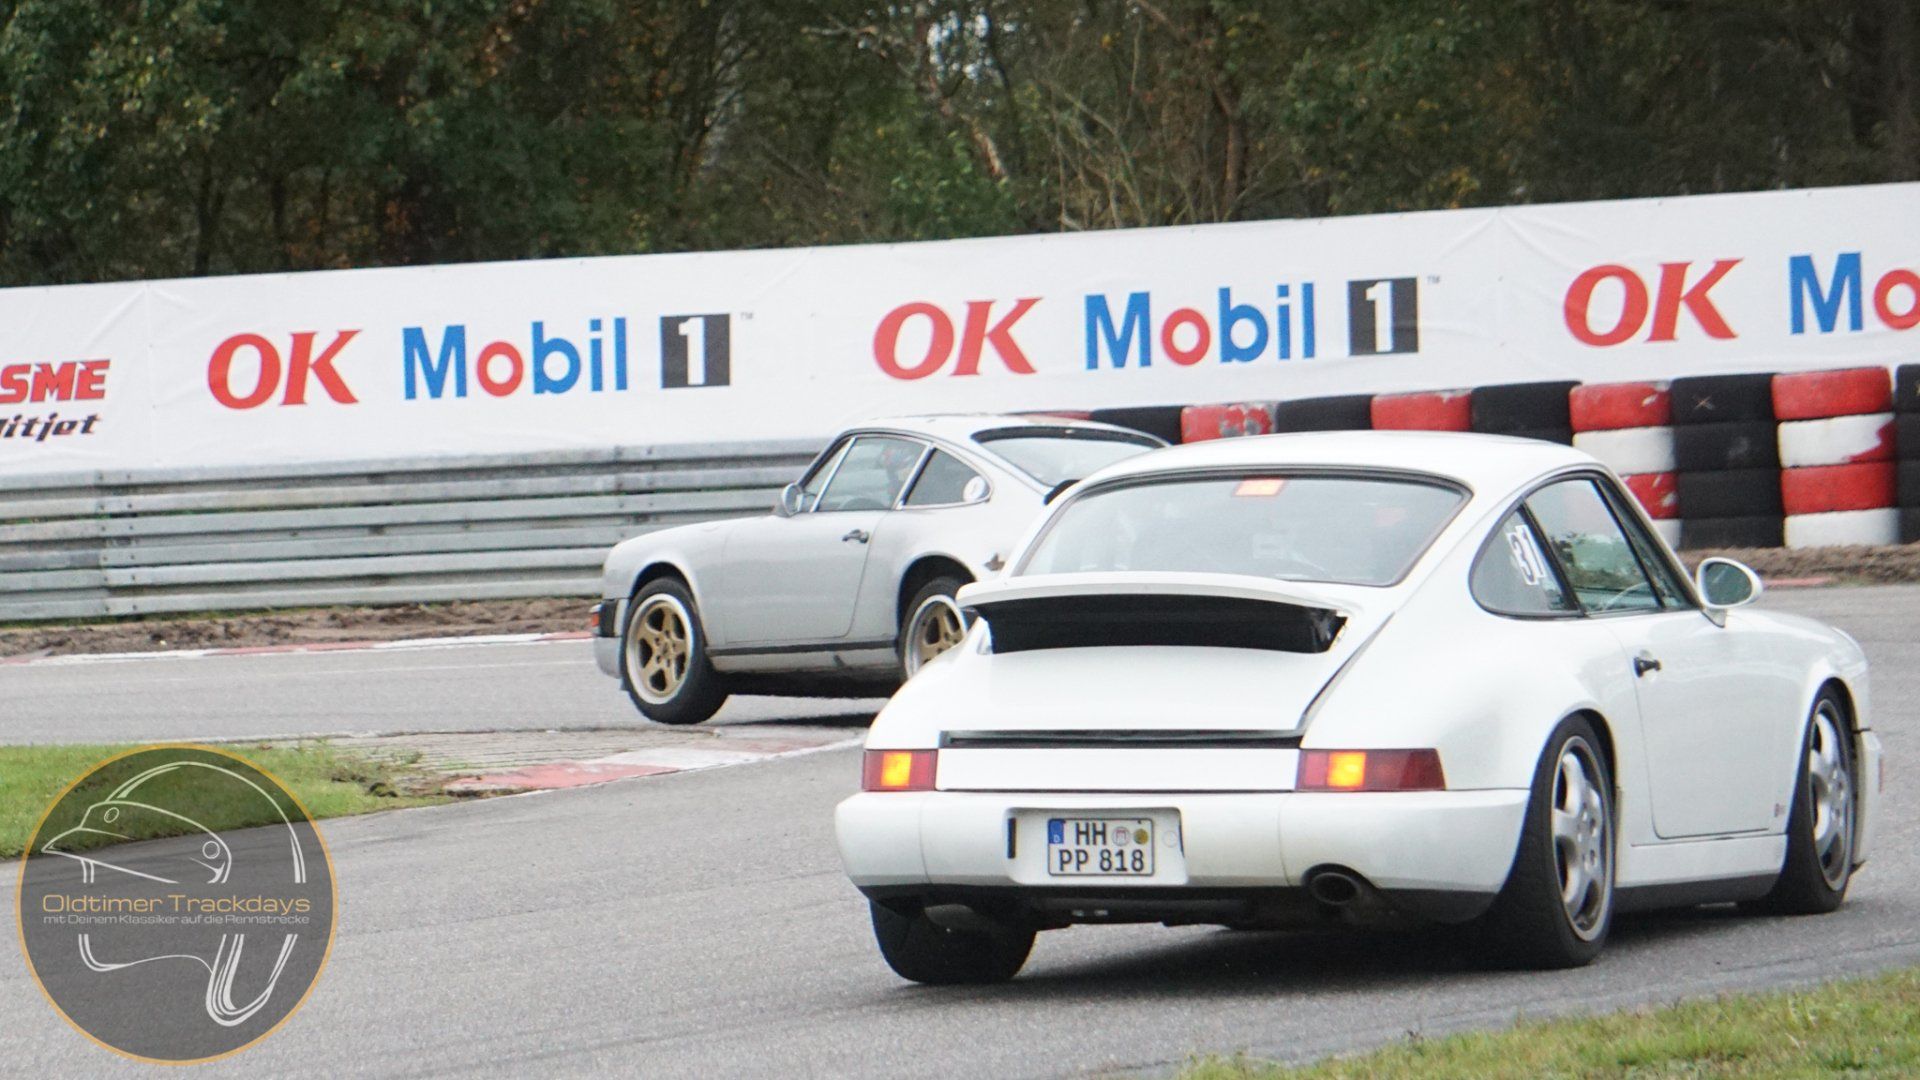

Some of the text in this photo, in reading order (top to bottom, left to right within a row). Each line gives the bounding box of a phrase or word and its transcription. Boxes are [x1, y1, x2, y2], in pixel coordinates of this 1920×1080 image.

[873, 297, 1042, 380] OK
[1084, 282, 1315, 371] Mobil
[1563, 258, 1743, 347] OK
[208, 329, 361, 409] OK
[402, 317, 627, 400] Mobil
[1059, 849, 1144, 872] PP 818
[1075, 822, 1107, 846] HH
